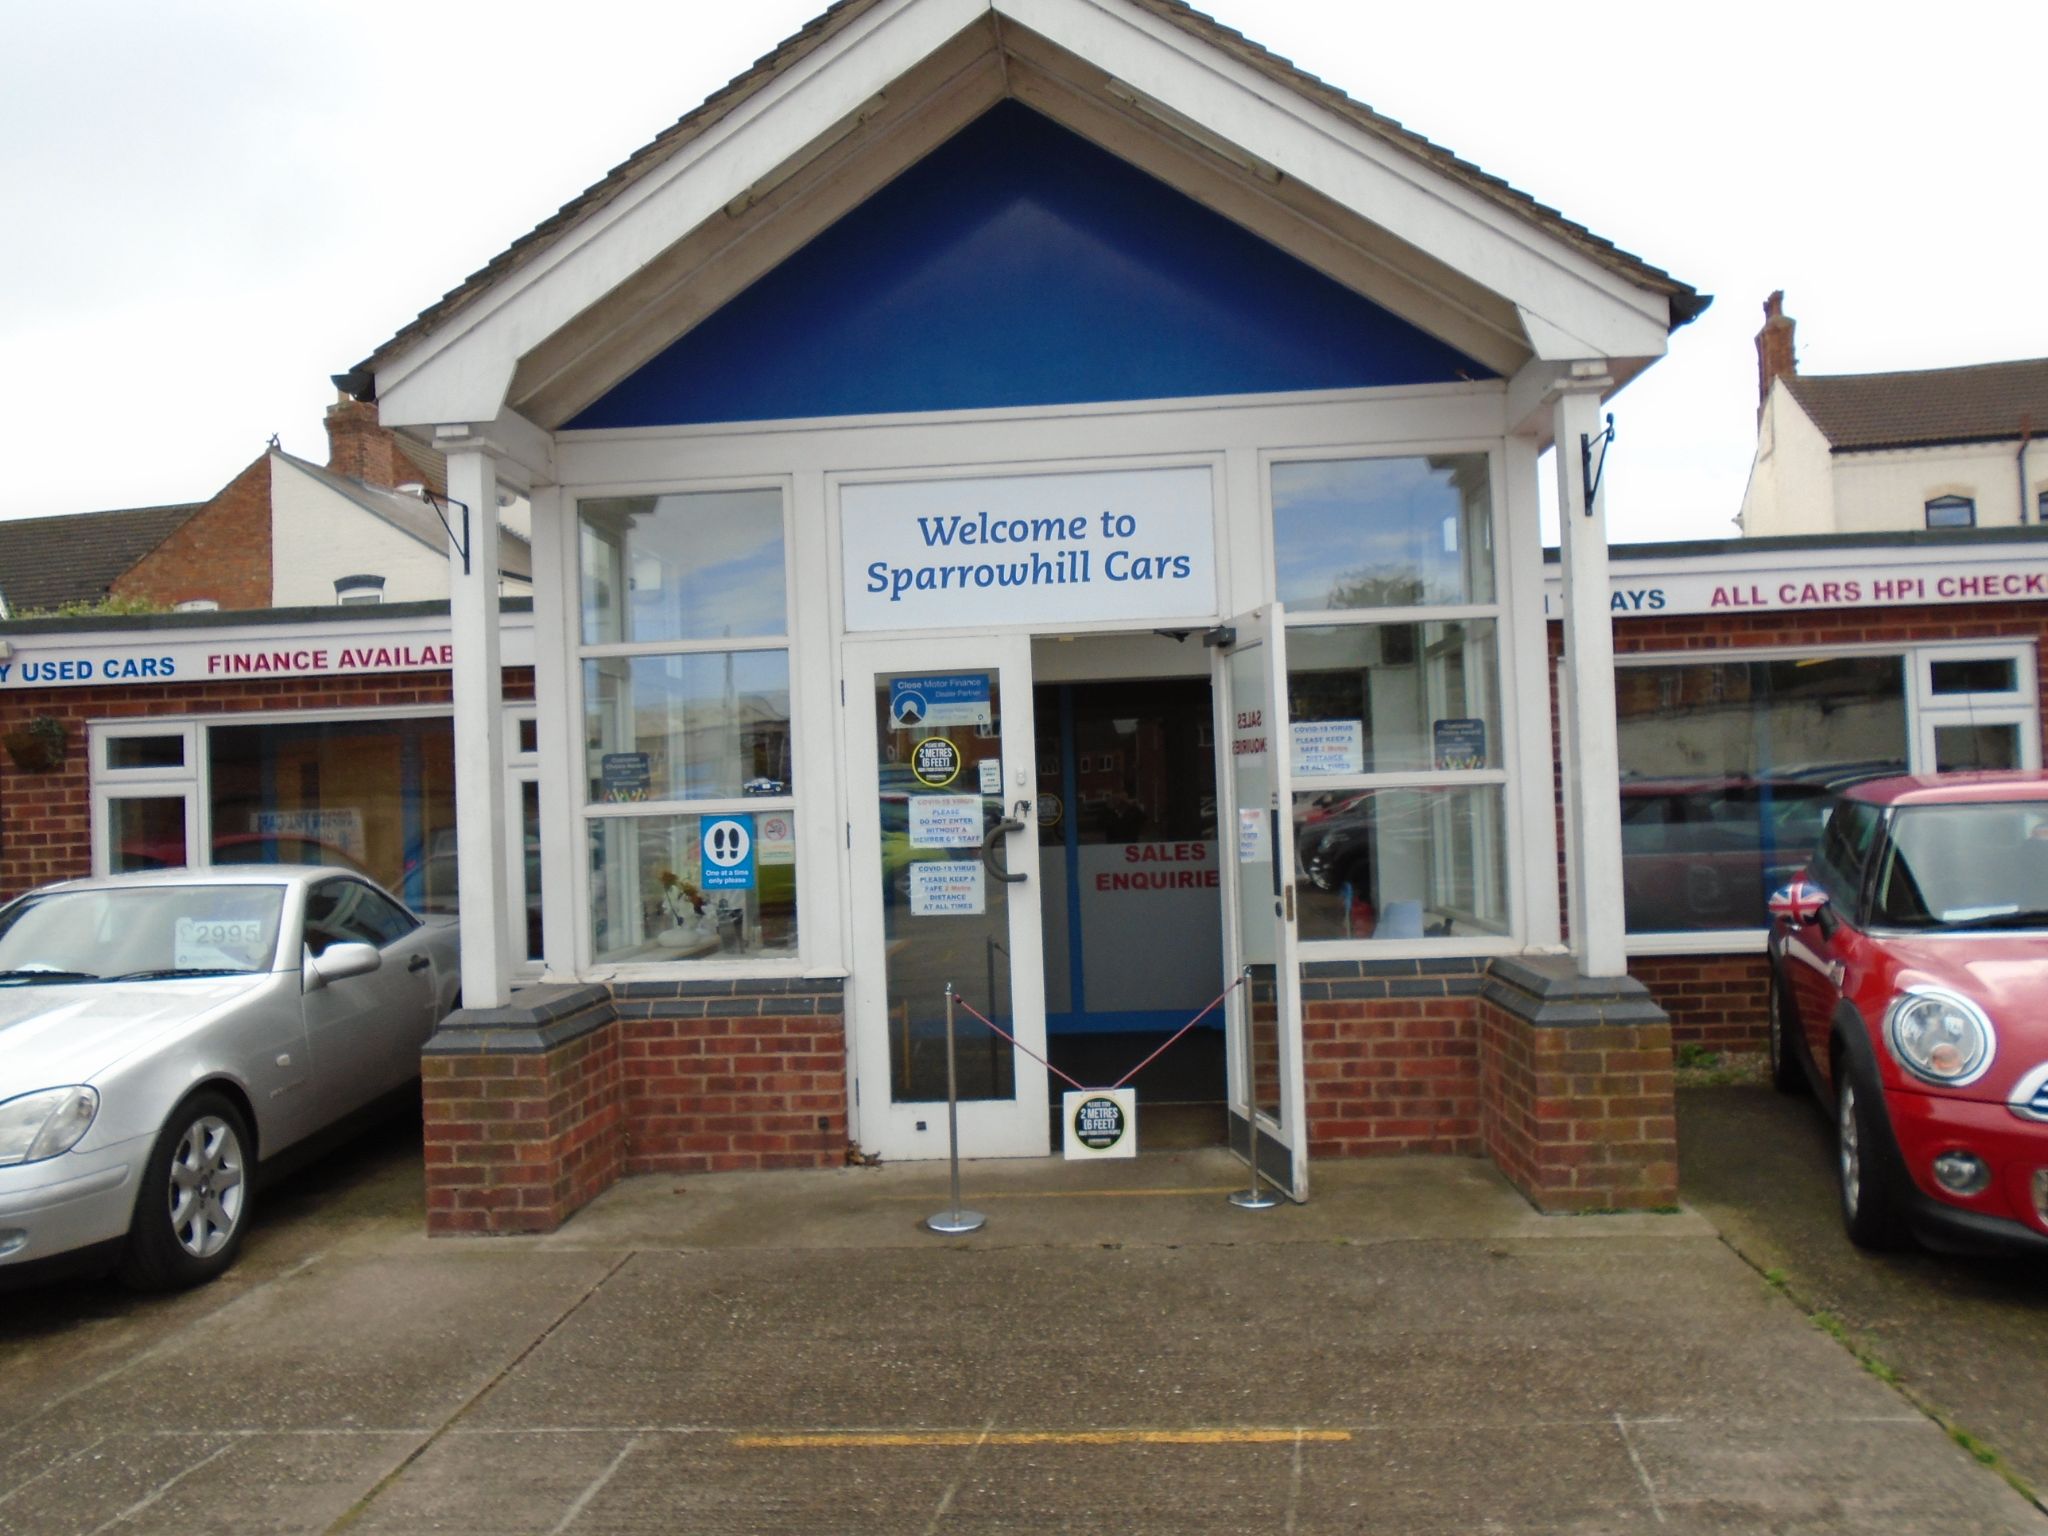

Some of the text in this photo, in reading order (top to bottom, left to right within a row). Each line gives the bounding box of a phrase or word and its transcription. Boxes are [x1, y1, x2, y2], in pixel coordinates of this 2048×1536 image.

[917, 511, 1137, 547] Welcome to
[867, 550, 1191, 601] Sparrowhill Cars
[1710, 572, 2046, 607] ALL CARS HPI CHECK
[21, 660, 93, 681] USED
[102, 656, 175, 678] CARS
[207, 650, 328, 674] FINANCE
[897, 679, 982, 689] Close Motor Finance
[919, 748, 952, 758] 2 METRES
[922, 757, 950, 767] (6 FEET)
[1125, 843, 1207, 862] SALES
[1096, 870, 1219, 891] ENQUIRIE
[1080, 1107, 1118, 1119] 2 METRES
[1083, 1119, 1115, 1130] (6 FEET)
